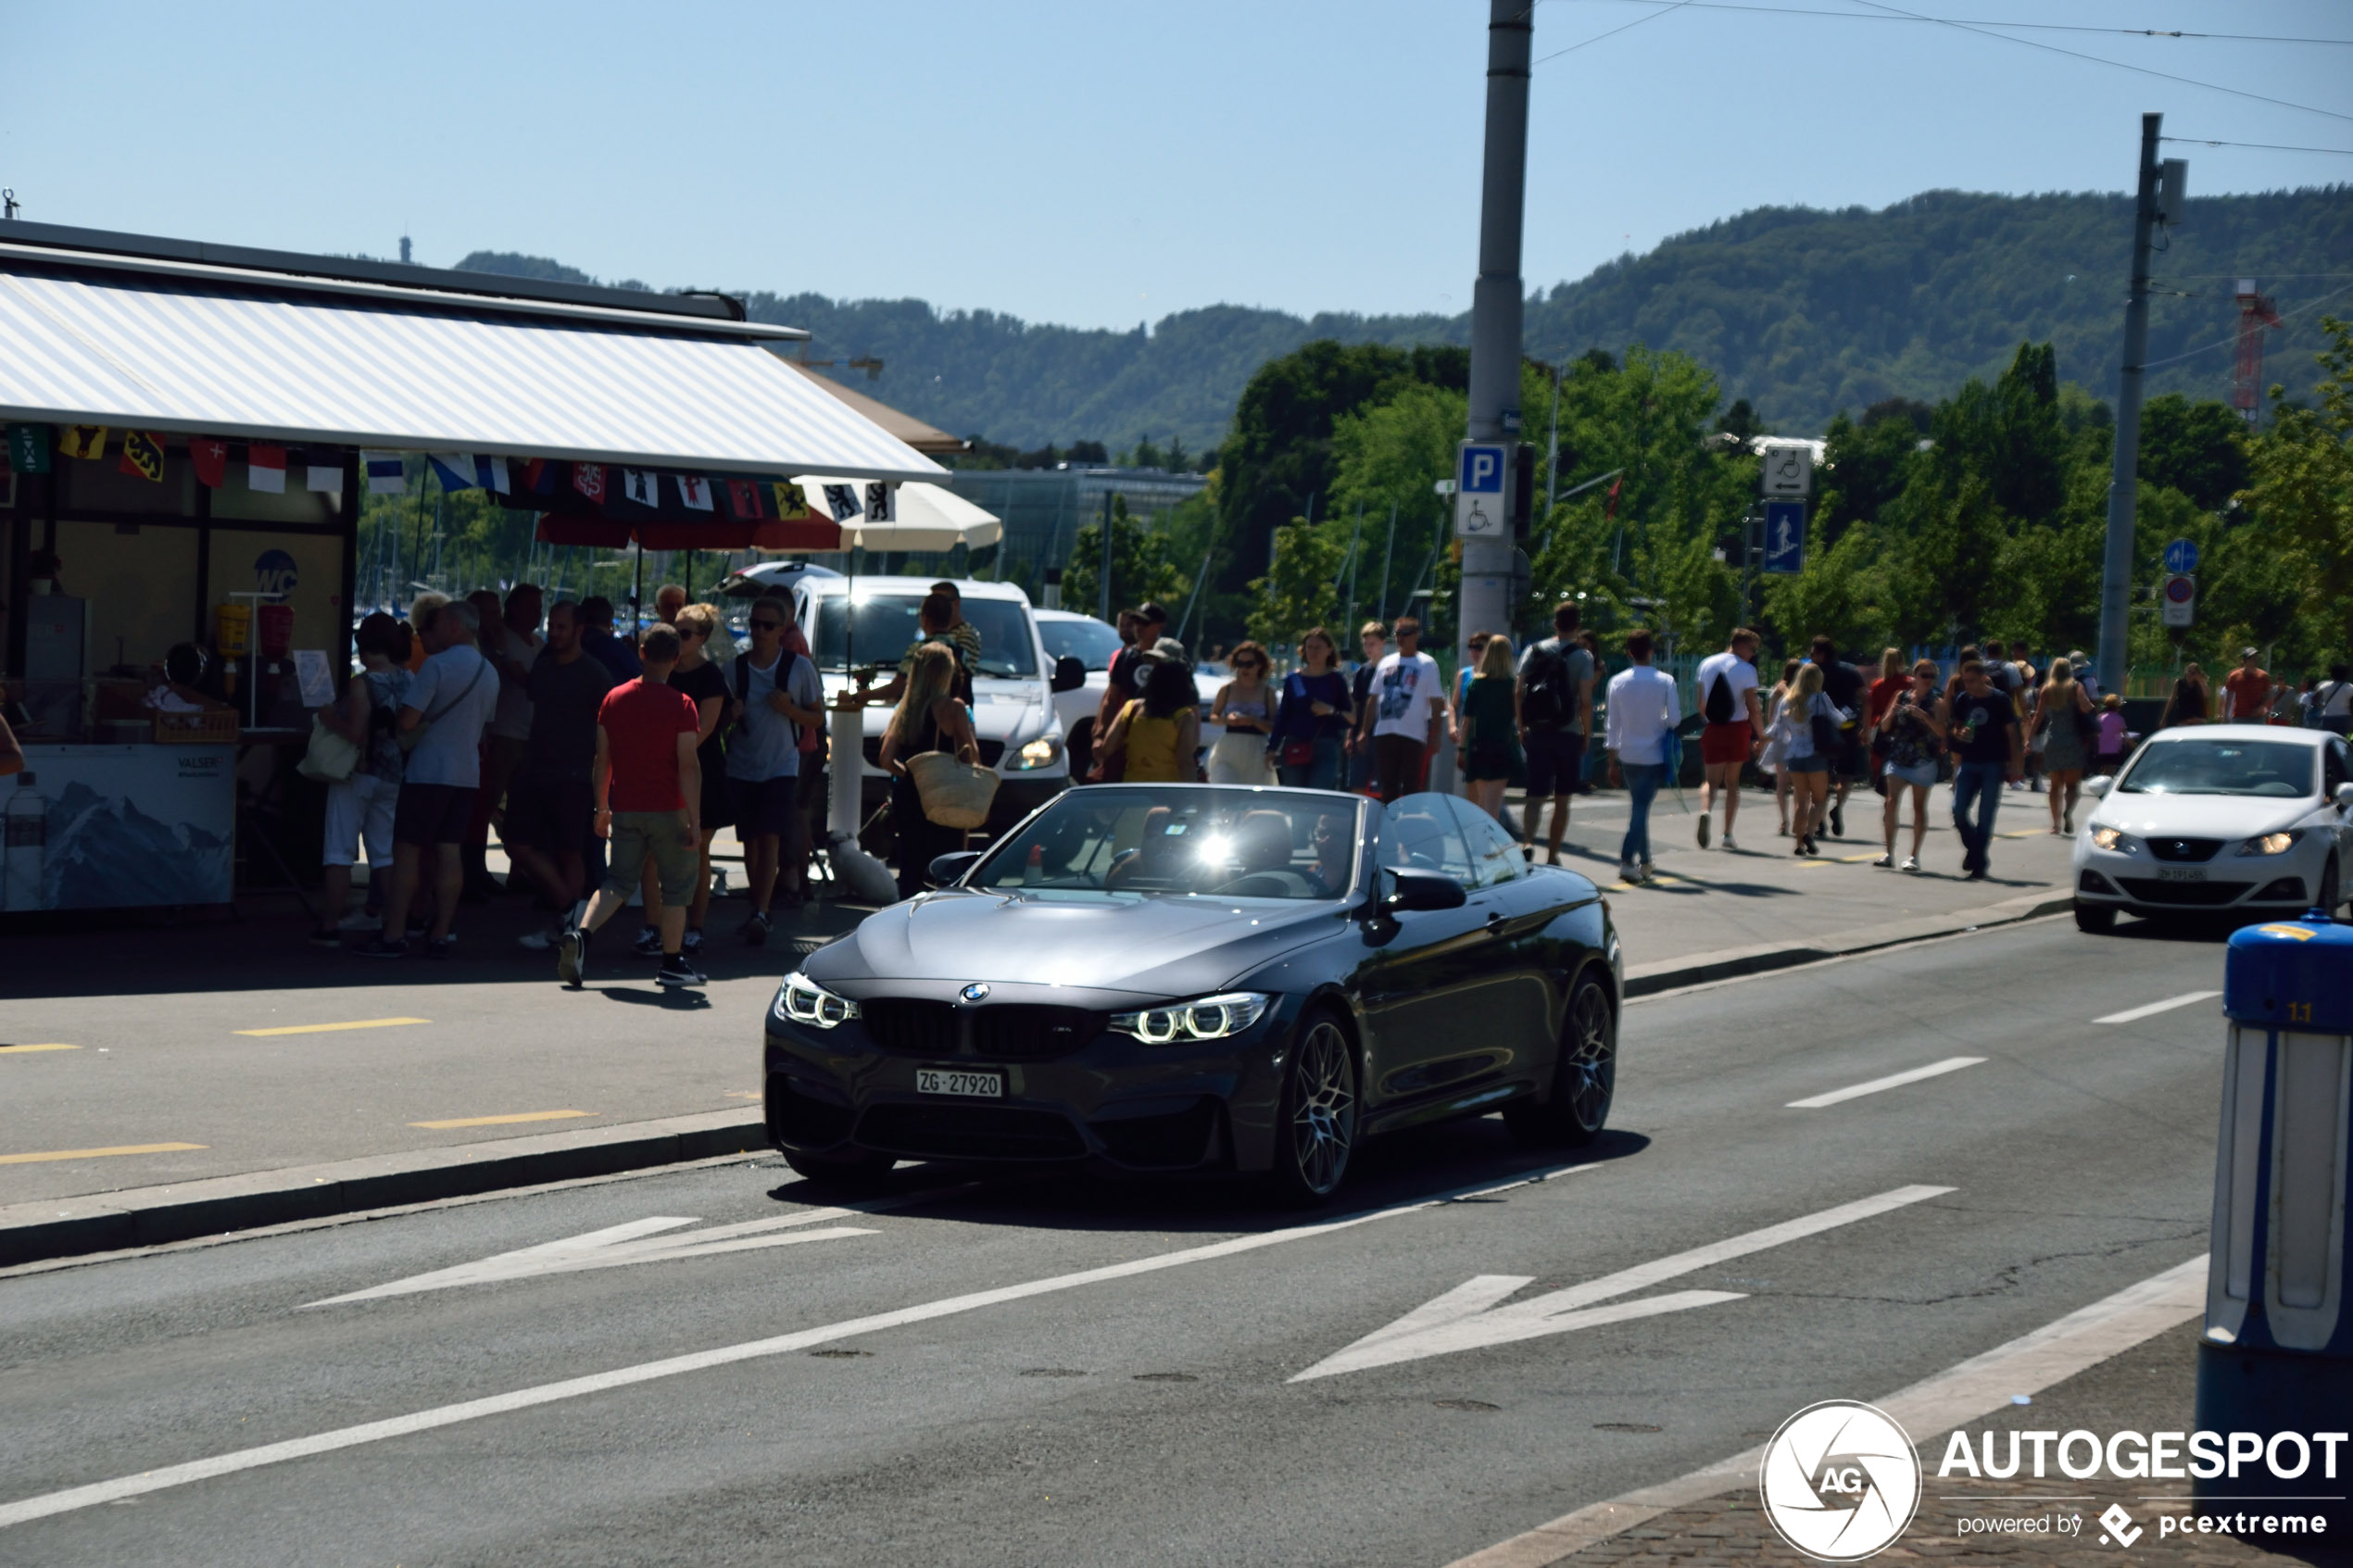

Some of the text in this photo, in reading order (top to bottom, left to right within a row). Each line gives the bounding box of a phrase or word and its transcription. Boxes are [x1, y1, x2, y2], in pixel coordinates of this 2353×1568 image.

[1472, 454, 1494, 488] P
[252, 569, 297, 595] WC
[178, 756, 218, 769] VALSER
[950, 1074, 998, 1095] 27920
